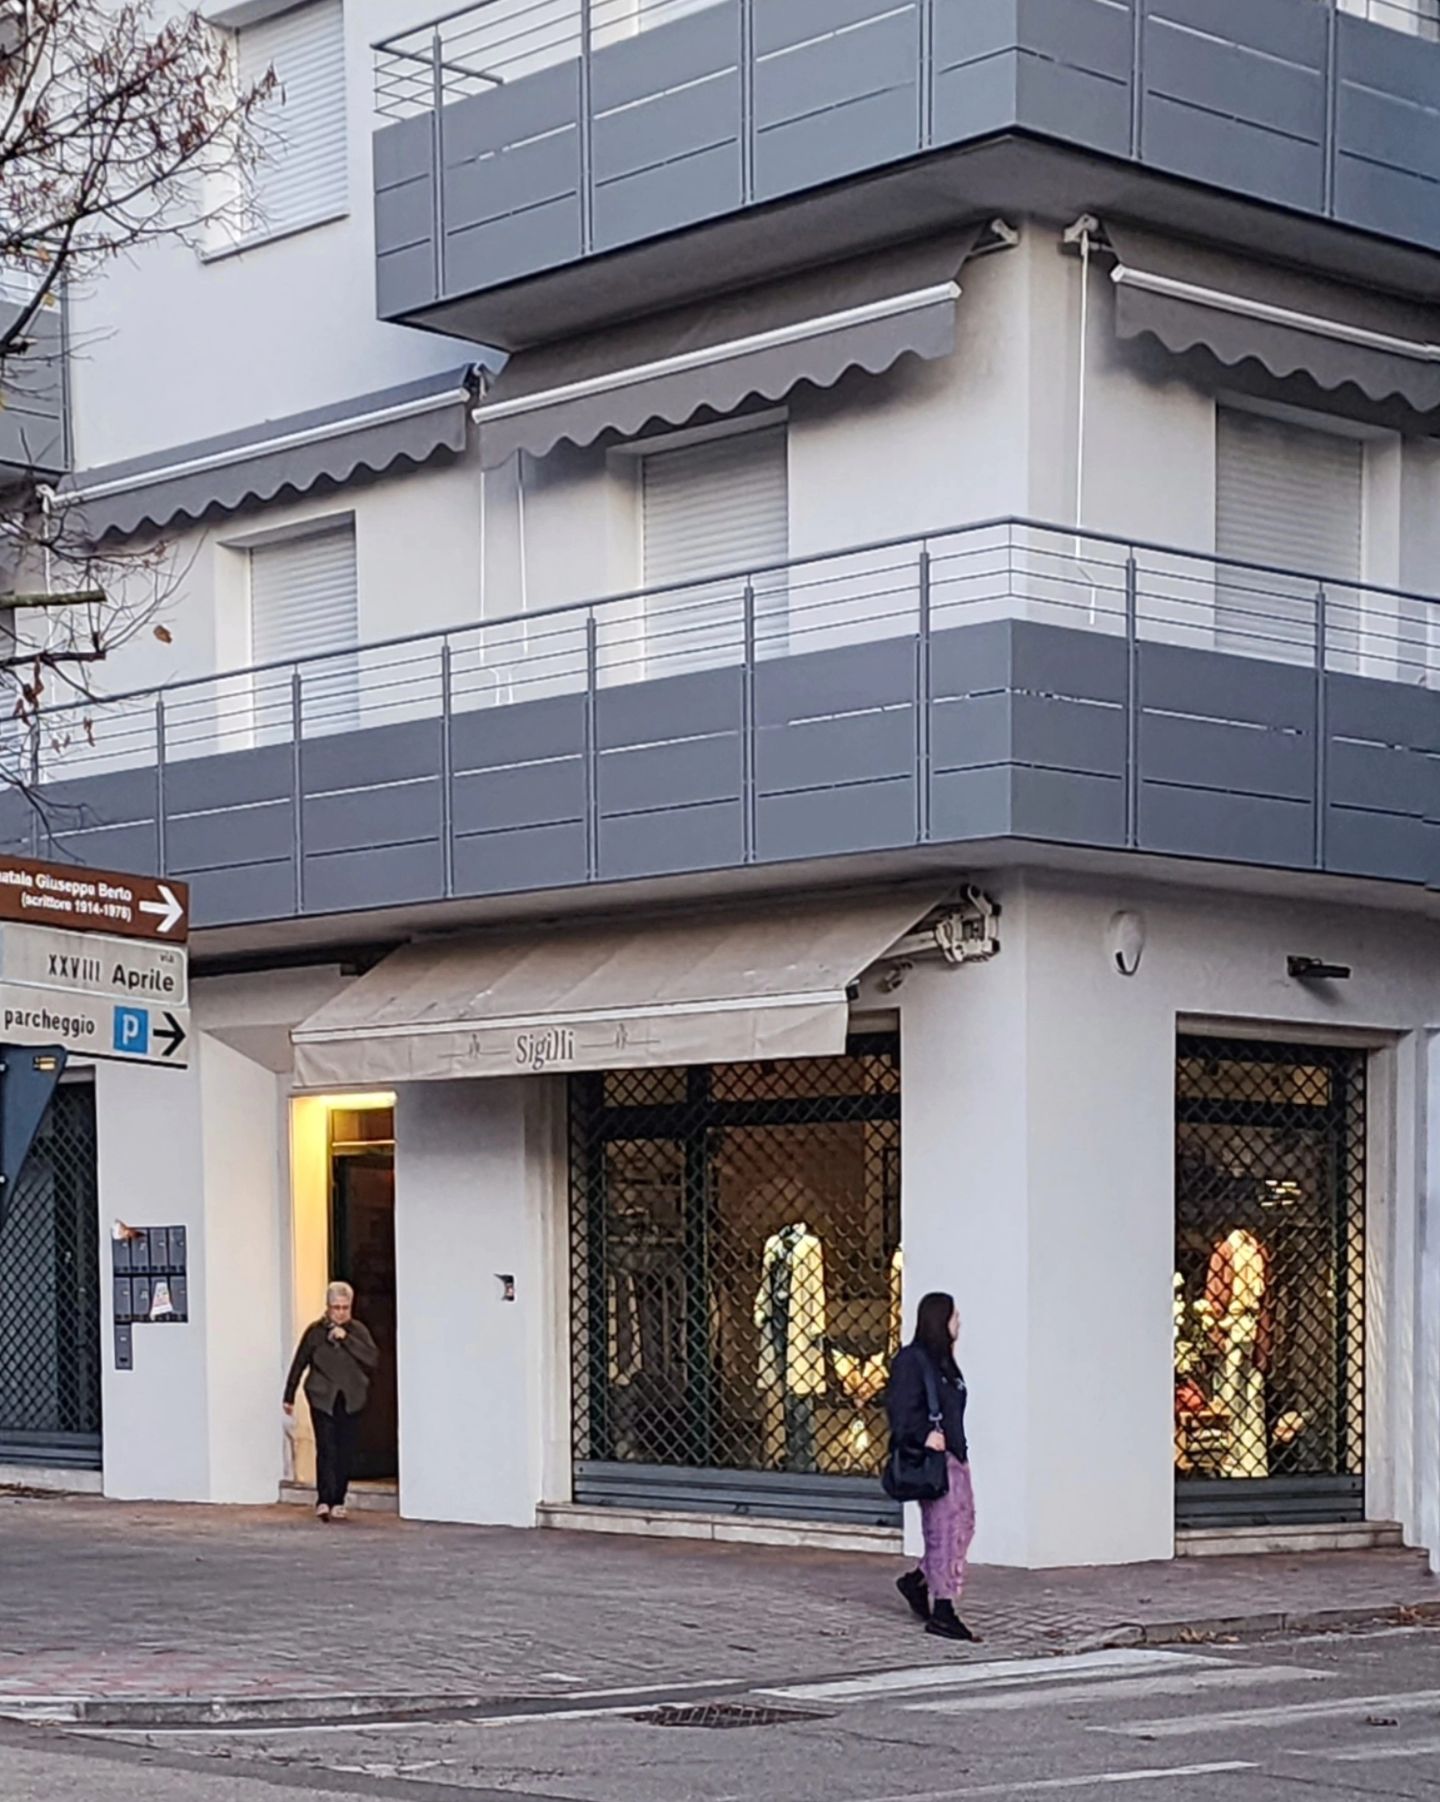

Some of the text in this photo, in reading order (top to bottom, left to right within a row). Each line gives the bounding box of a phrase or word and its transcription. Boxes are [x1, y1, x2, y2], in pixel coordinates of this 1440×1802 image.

[0, 870, 132, 902] atale Giuseppe Berto
[21, 891, 72, 911] (scrittore
[49, 954, 174, 992] XXVIII Aprile
[160, 952, 175, 964] via
[4, 1008, 140, 1046] parcheggio P
[515, 1029, 574, 1071] Sigilli
